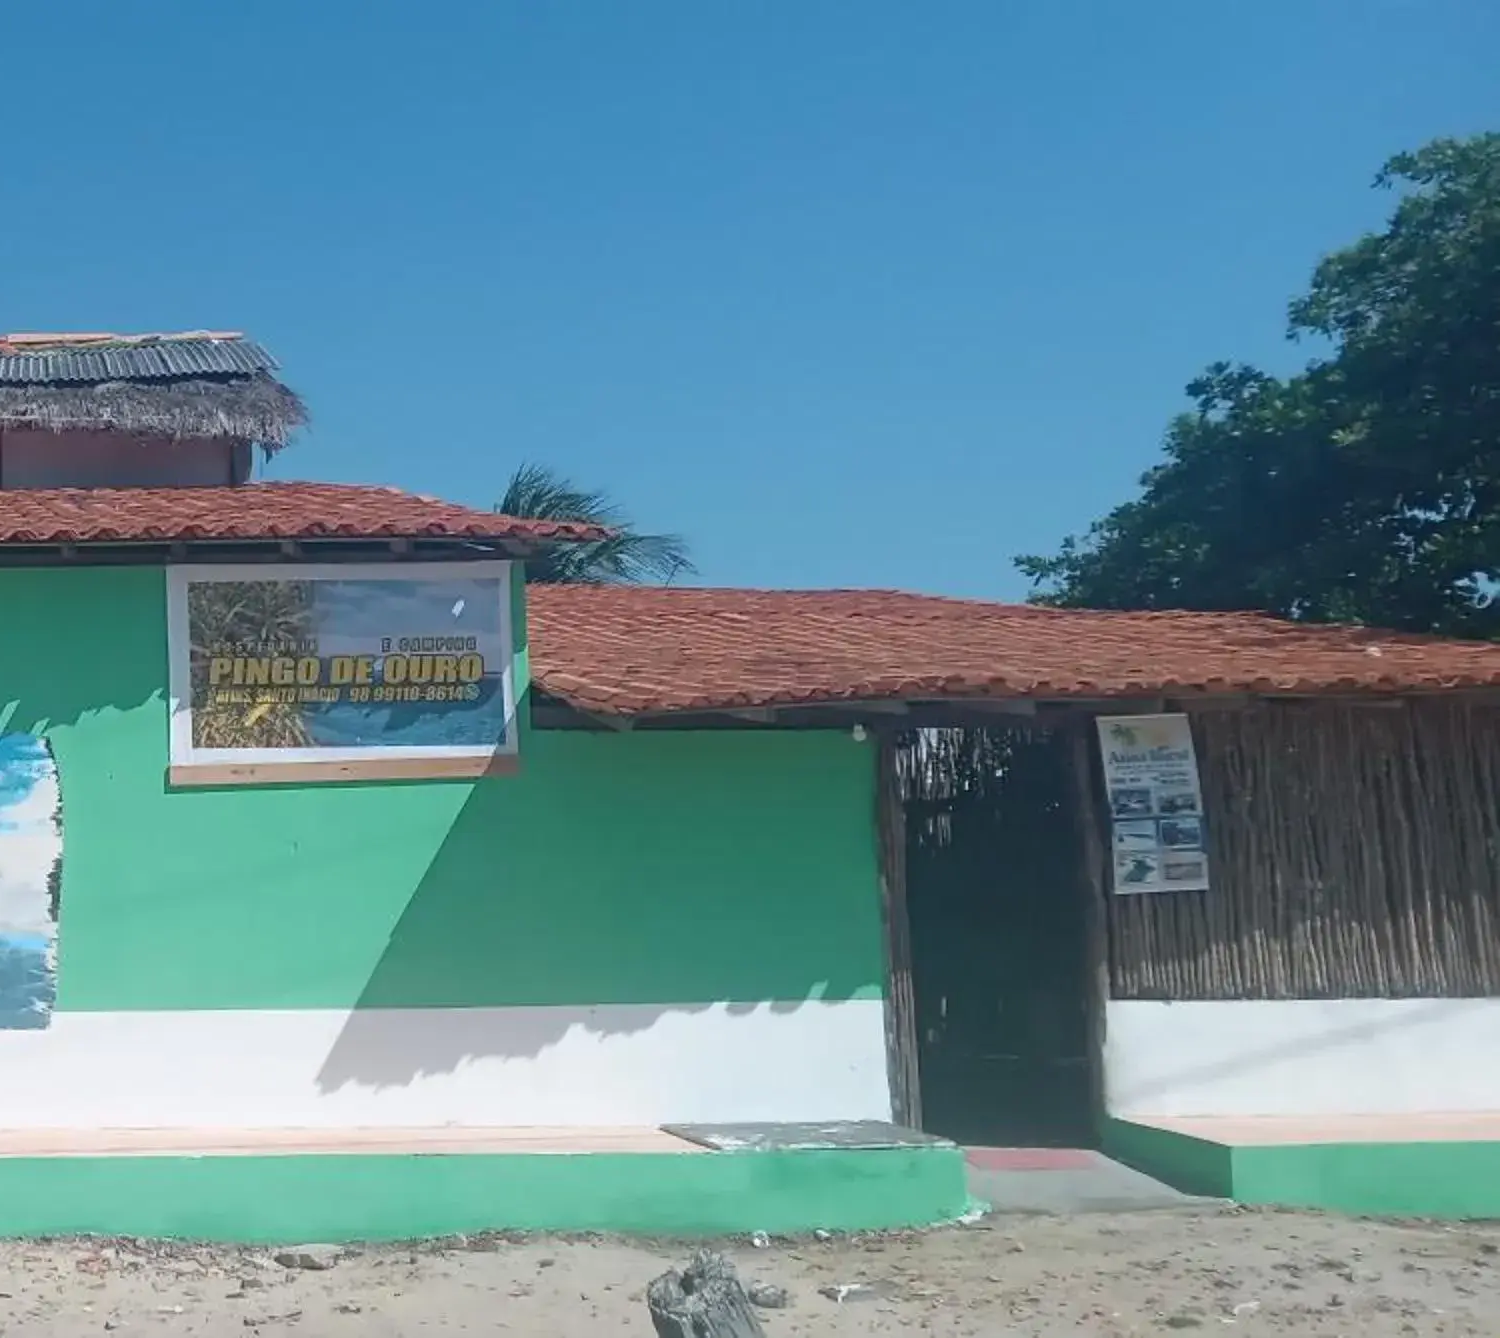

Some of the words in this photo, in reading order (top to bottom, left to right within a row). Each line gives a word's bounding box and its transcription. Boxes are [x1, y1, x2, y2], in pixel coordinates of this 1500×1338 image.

[209, 656, 321, 685] PINGO
[329, 656, 374, 684] DE
[382, 654, 484, 684] OURO
[350, 686, 371, 703] 98
